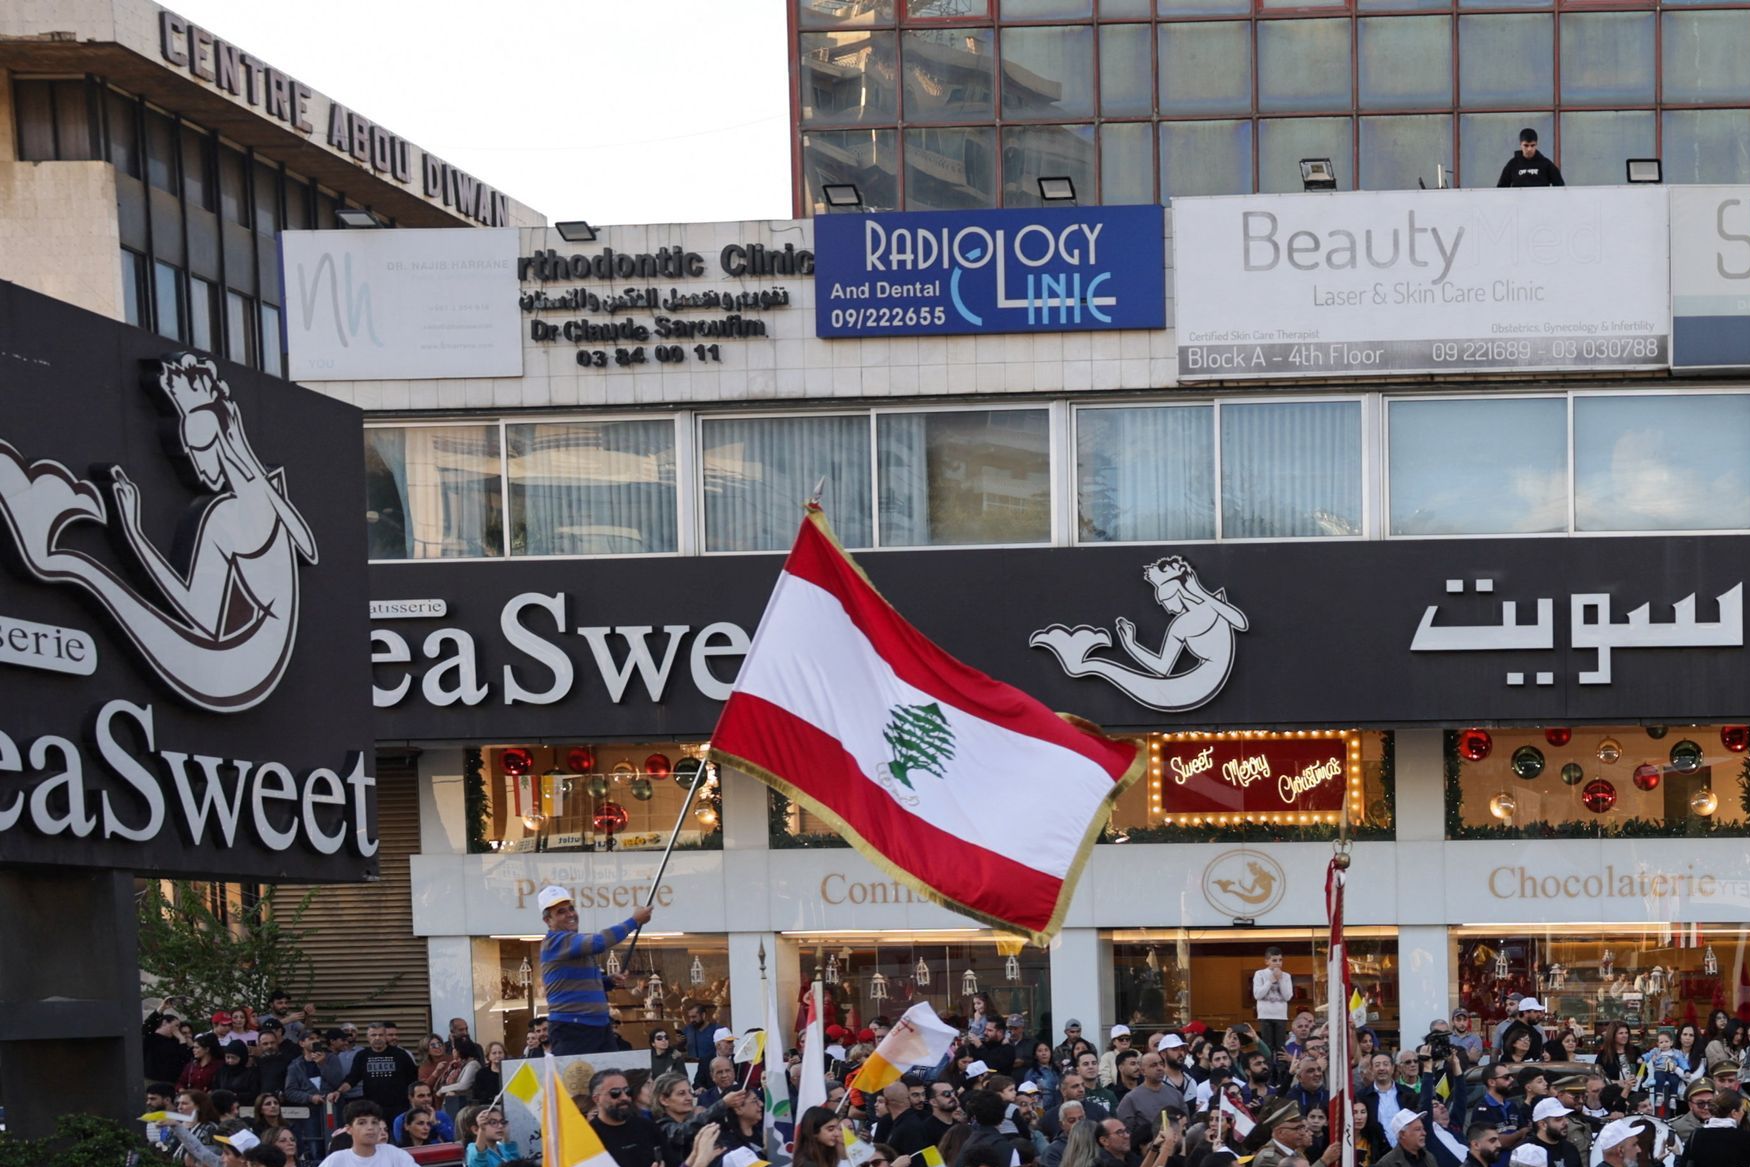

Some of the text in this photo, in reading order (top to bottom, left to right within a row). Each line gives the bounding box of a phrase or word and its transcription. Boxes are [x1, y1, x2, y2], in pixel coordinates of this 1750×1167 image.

[159, 10, 511, 228] CENTRE ABOU DIWAN
[517, 242, 815, 282] rthodontic Clinic
[865, 218, 1103, 297] RADIOLOGY
[831, 280, 940, 299] And Dental
[1313, 277, 1546, 308] Laser & Skin Care Clinic
[562, 317, 650, 342] Claude
[831, 307, 946, 329] 09/222655
[1189, 328, 1320, 343] Certified Skin Care Therapist
[1432, 342, 1457, 362] 09
[1463, 341, 1531, 361] 221689
[1551, 340, 1577, 359] 03
[1582, 339, 1658, 359] 030788
[576, 344, 721, 367] 03 84 00 11
[1187, 347, 1246, 369] Block
[1250, 348, 1267, 367] A
[1287, 346, 1323, 367] 4th
[1330, 344, 1384, 366] Floor
[369, 600, 442, 615] atisserie
[1410, 578, 1744, 685] سويت
[371, 592, 753, 709] eaSwe
[1170, 745, 1214, 785] Sweet
[1278, 756, 1342, 804] Christmas
[515, 874, 674, 910] Pisserie
[1488, 866, 1717, 901] Chocolaterie
